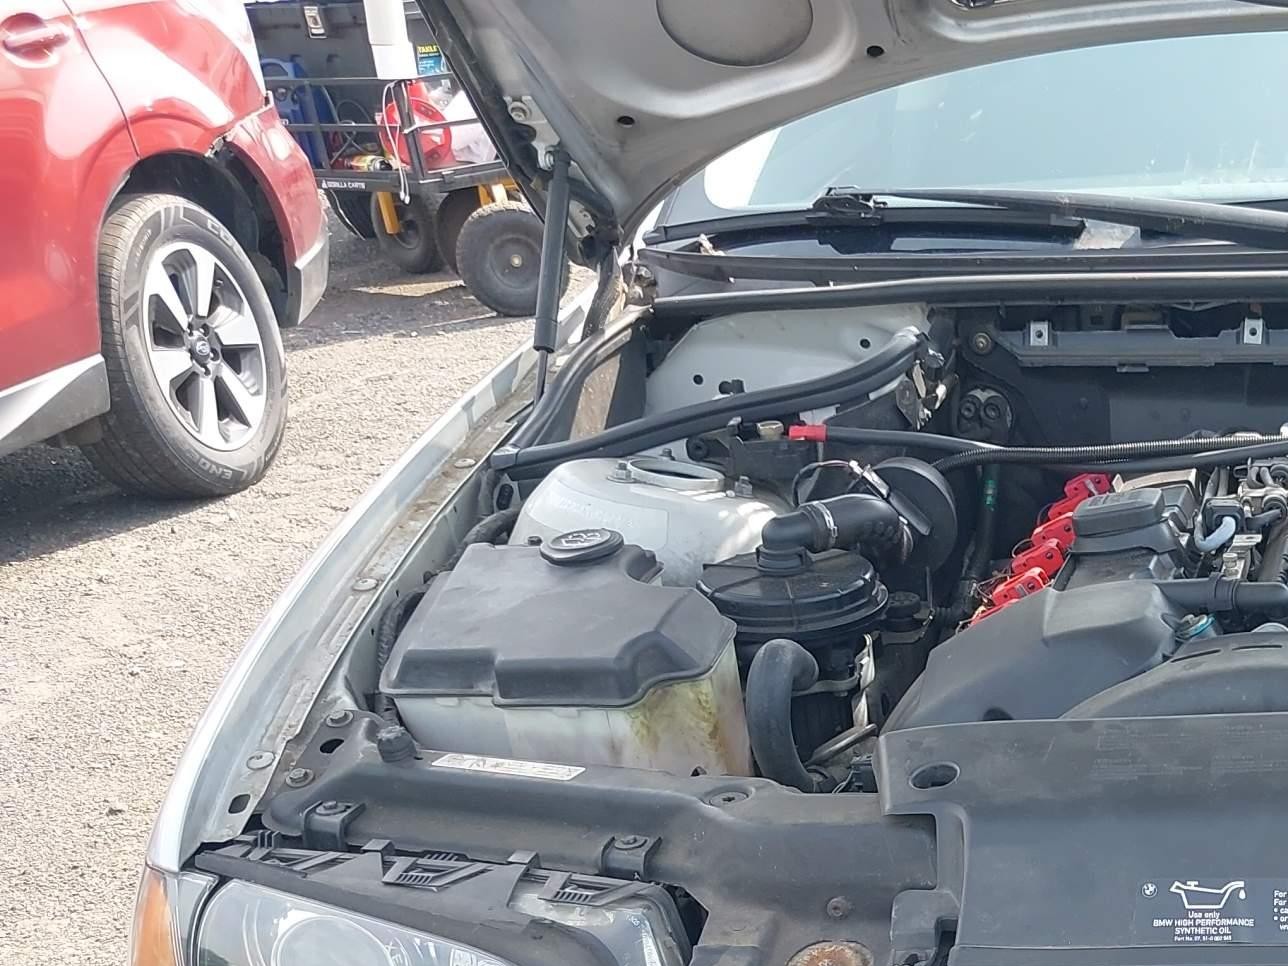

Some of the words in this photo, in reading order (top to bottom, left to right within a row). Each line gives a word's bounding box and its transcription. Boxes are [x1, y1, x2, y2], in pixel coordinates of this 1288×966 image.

[1273, 889, 1288, 898] For
[1273, 898, 1287, 906] For
[1188, 910, 1202, 918] Use
[1204, 910, 1220, 919] only
[1152, 919, 1173, 927] BMW
[1174, 919, 1194, 927] HIGH
[1195, 919, 1255, 927] PERFORMANCE
[1174, 927, 1218, 935] SYNTHETIC
